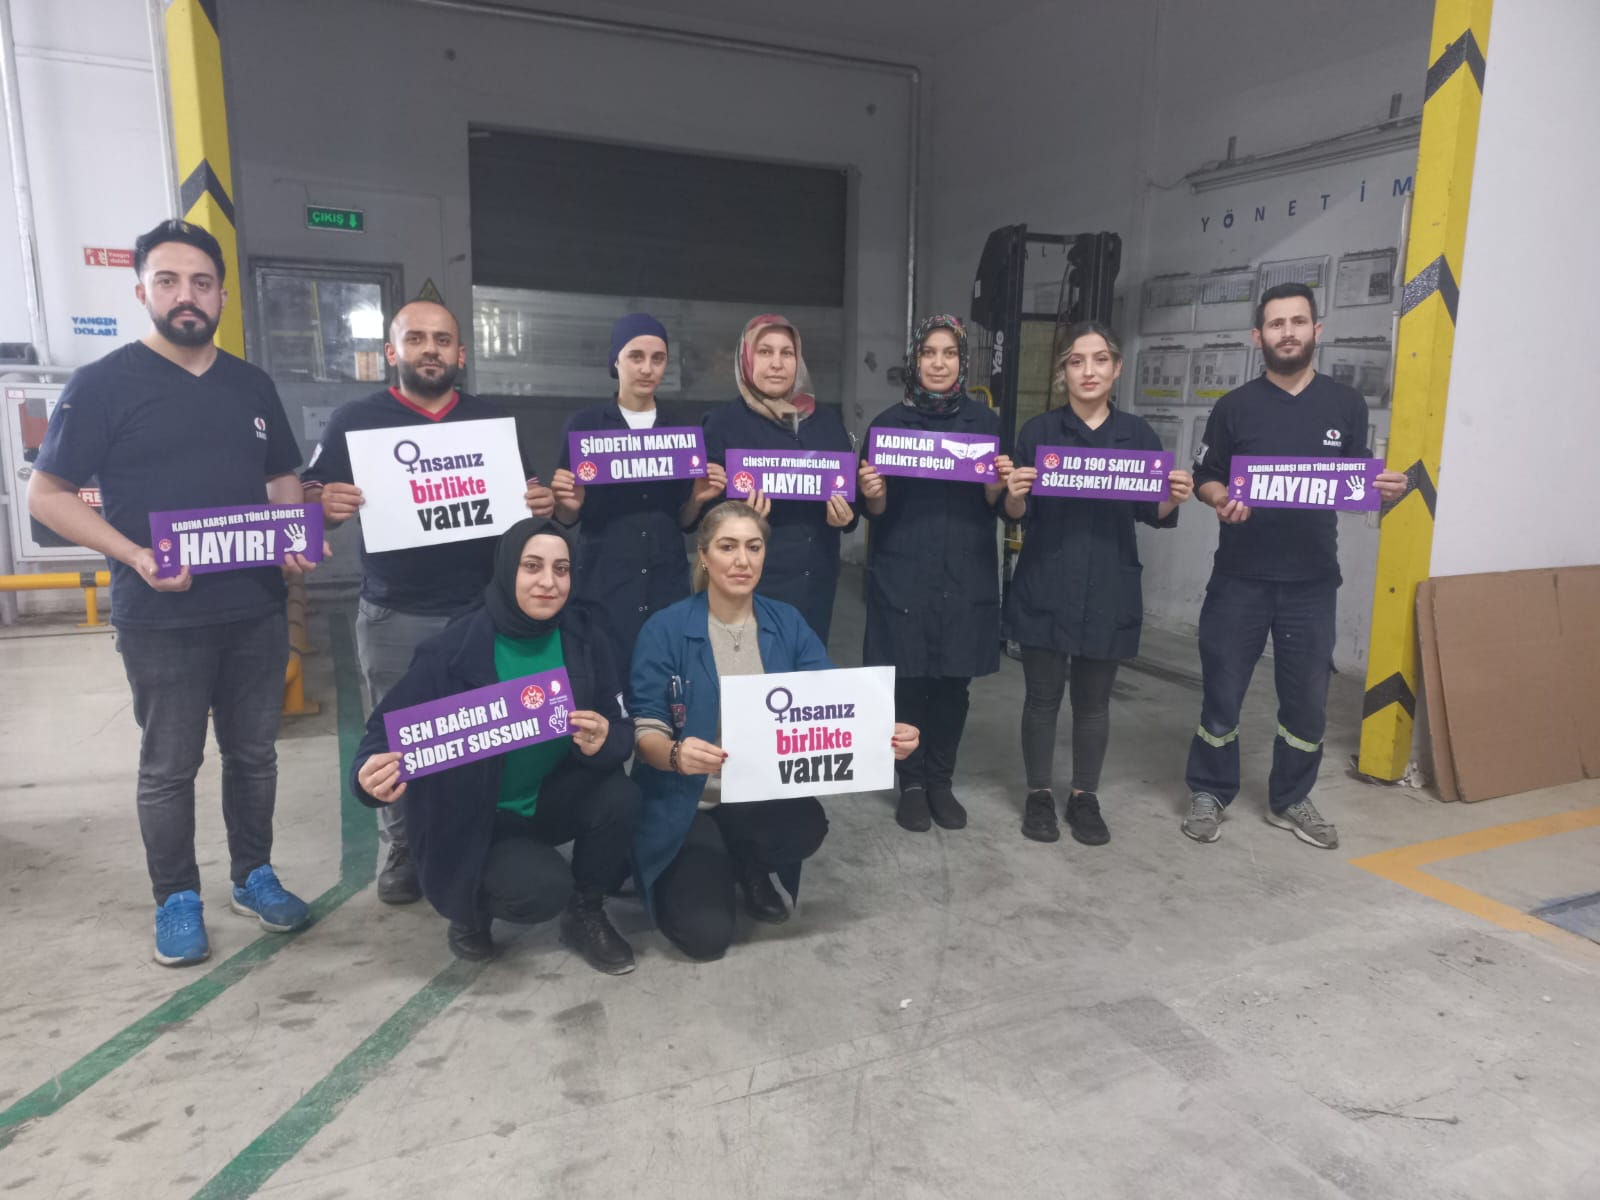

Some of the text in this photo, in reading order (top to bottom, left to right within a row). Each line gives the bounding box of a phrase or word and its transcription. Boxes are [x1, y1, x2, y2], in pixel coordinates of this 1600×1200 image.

[1201, 176, 1412, 232] YÖNETİM
[312, 211, 344, 225] ÇIKIŞ
[992, 330, 1005, 376] Yale
[580, 433, 697, 457] ŞİDDETİN MAKYAJI
[876, 434, 934, 452] KADINLAR
[610, 456, 674, 480] OLMAZ!
[742, 456, 840, 470] CİNSİYET AYRIMCILIĞINA
[875, 452, 955, 471] BİRLİKTE GÜÇLÜ!
[1063, 456, 1146, 473] ILO 190 SAYILI
[1247, 462, 1366, 473] KADINA KARŞI HER TÜRLÜ ŞİDDETE
[409, 476, 487, 504] birlikte
[762, 473, 822, 495] HAYIR!
[1041, 472, 1163, 492] SÖZLEŞMEYİ İMZALA!
[1250, 474, 1339, 506] HAYIR!
[172, 508, 305, 533] KADINA KARŞI HER TÜRLÜ ŞİDDETE
[417, 498, 493, 531] varız
[179, 530, 276, 566] HAYIR!
[398, 720, 434, 746] SEN
[435, 706, 488, 736] BAĞIR
[489, 697, 508, 721] Kİ
[403, 717, 540, 775] ŞİDDET SUSSUN!
[776, 727, 852, 755] birlikte
[778, 753, 854, 784] varız
